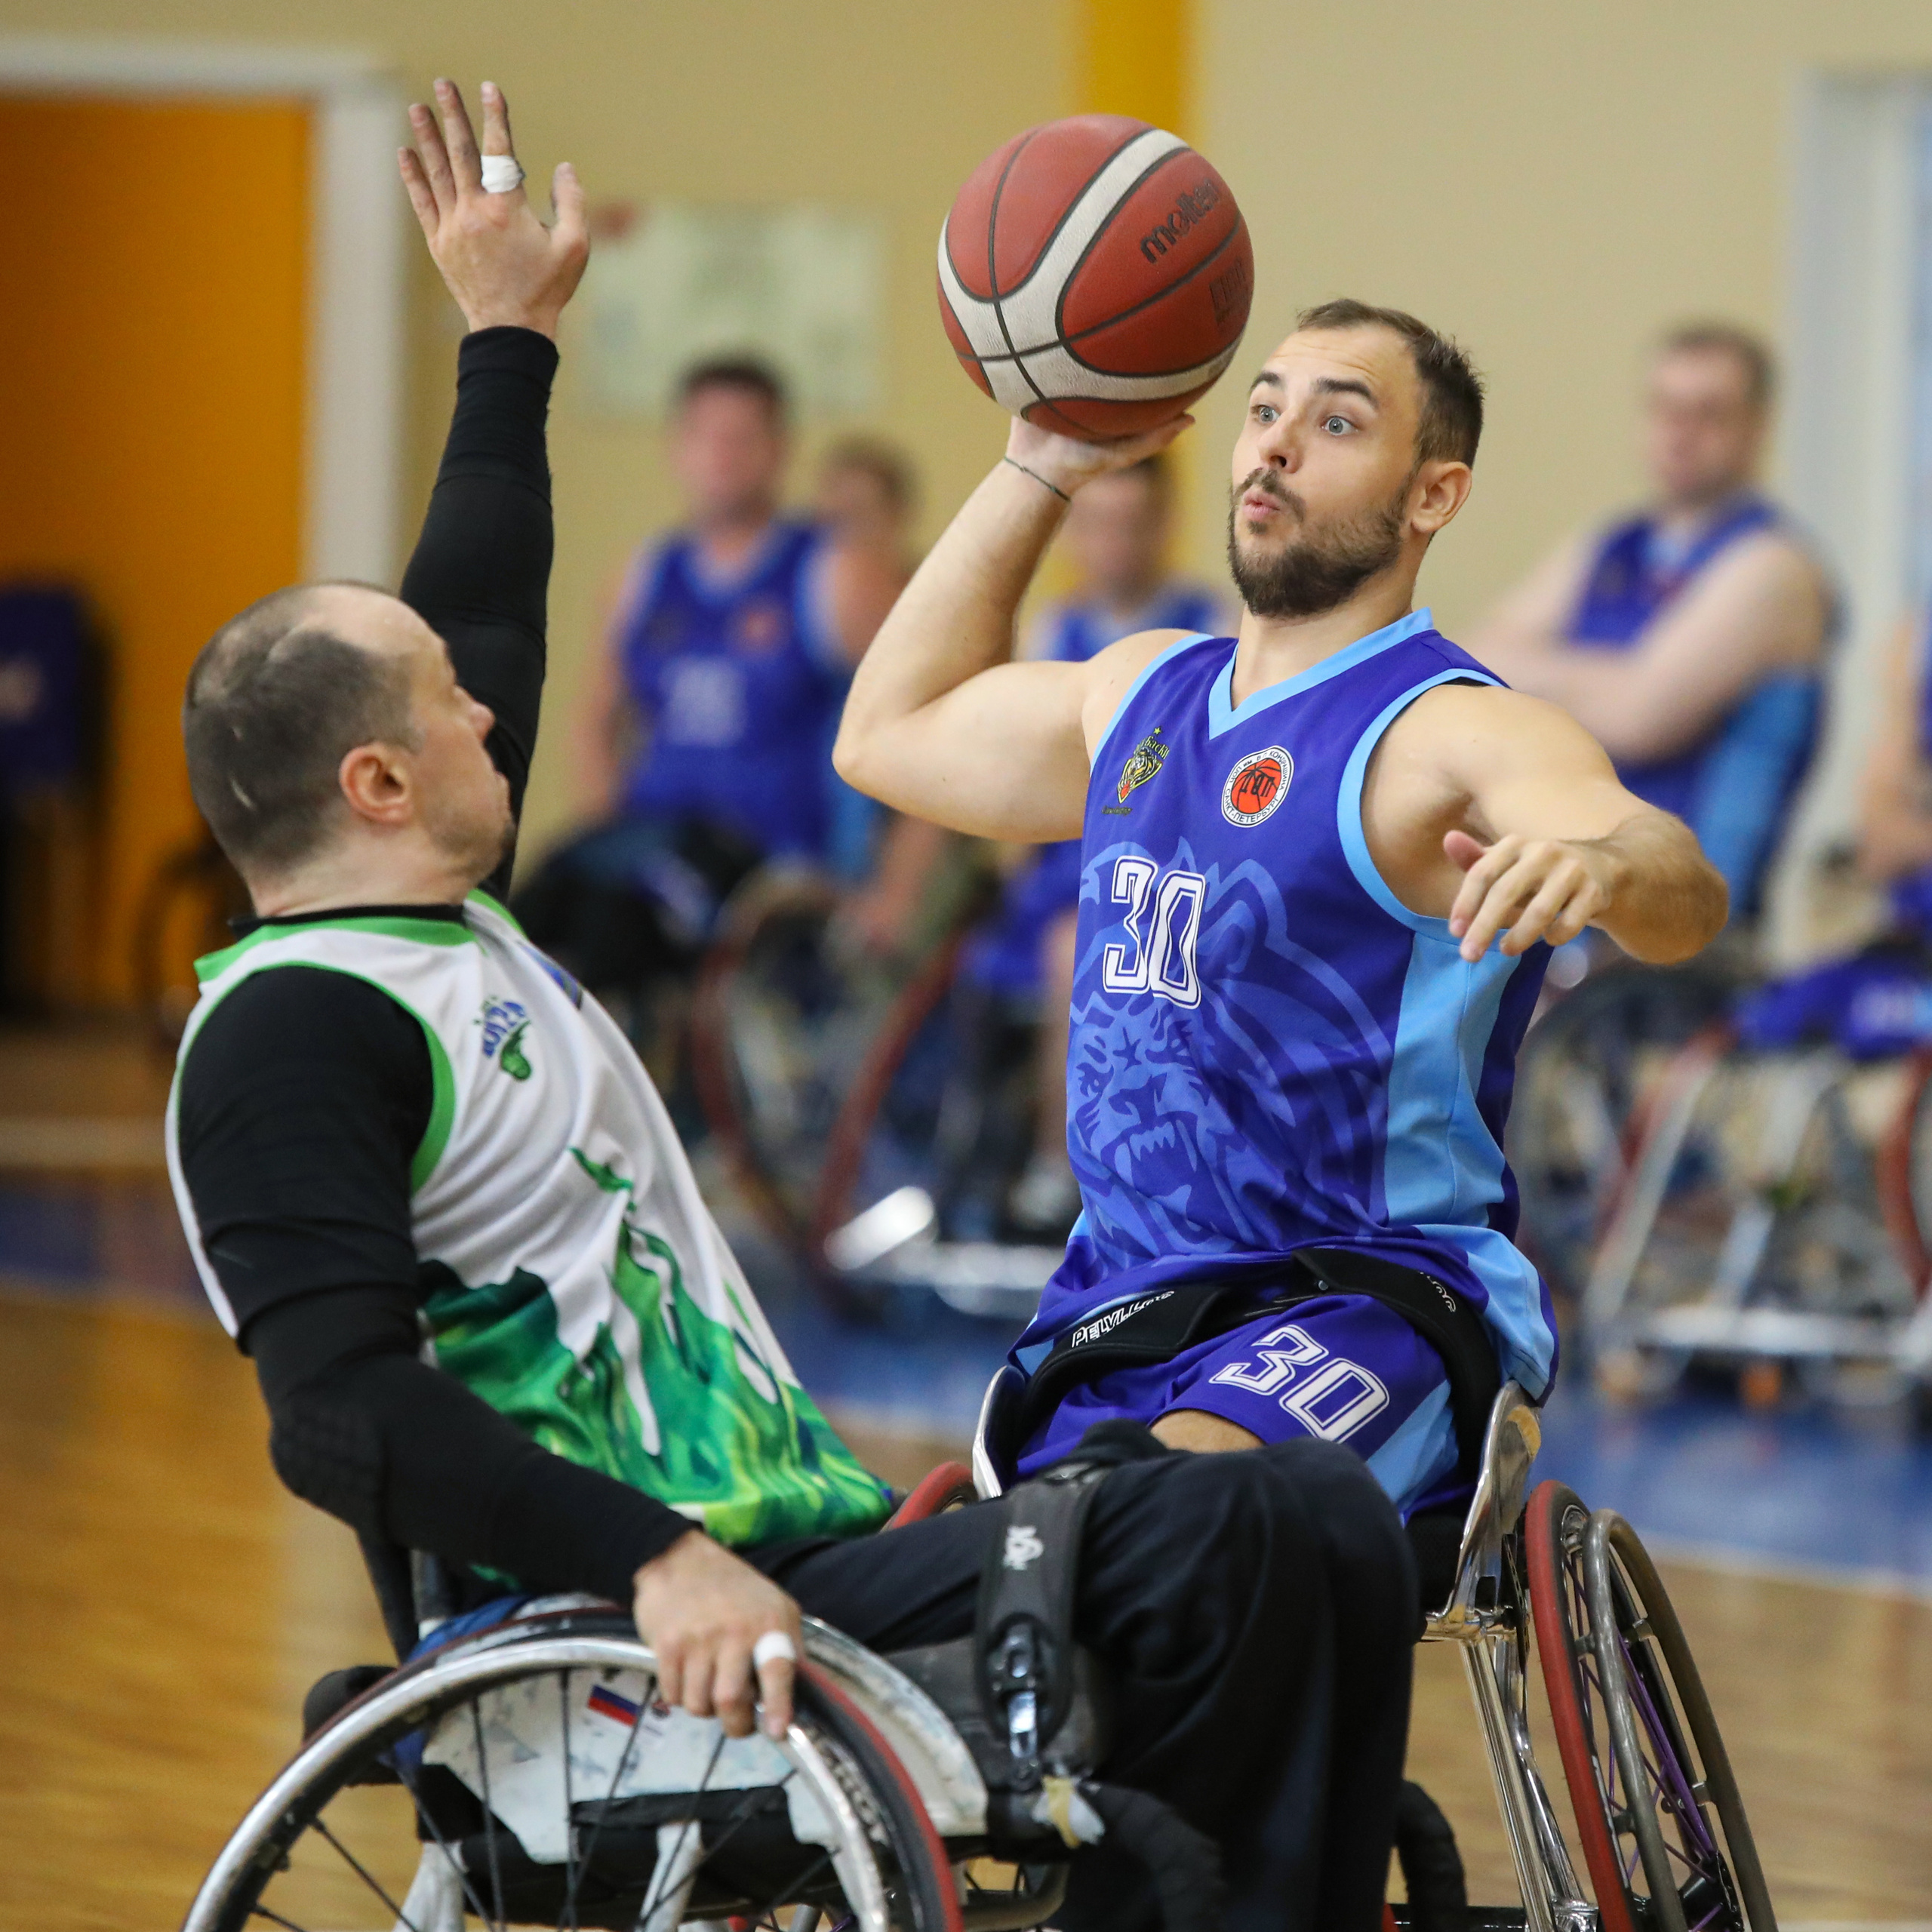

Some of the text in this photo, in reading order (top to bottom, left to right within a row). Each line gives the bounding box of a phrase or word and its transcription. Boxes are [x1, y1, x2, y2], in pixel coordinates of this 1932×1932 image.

[1140, 177, 1222, 264] molten
[1224, 788, 1279, 823] САНКТ-ПЕТЕРБУРГ
[1103, 855, 1206, 1010] 30
[1208, 1324, 1390, 1445] 30
